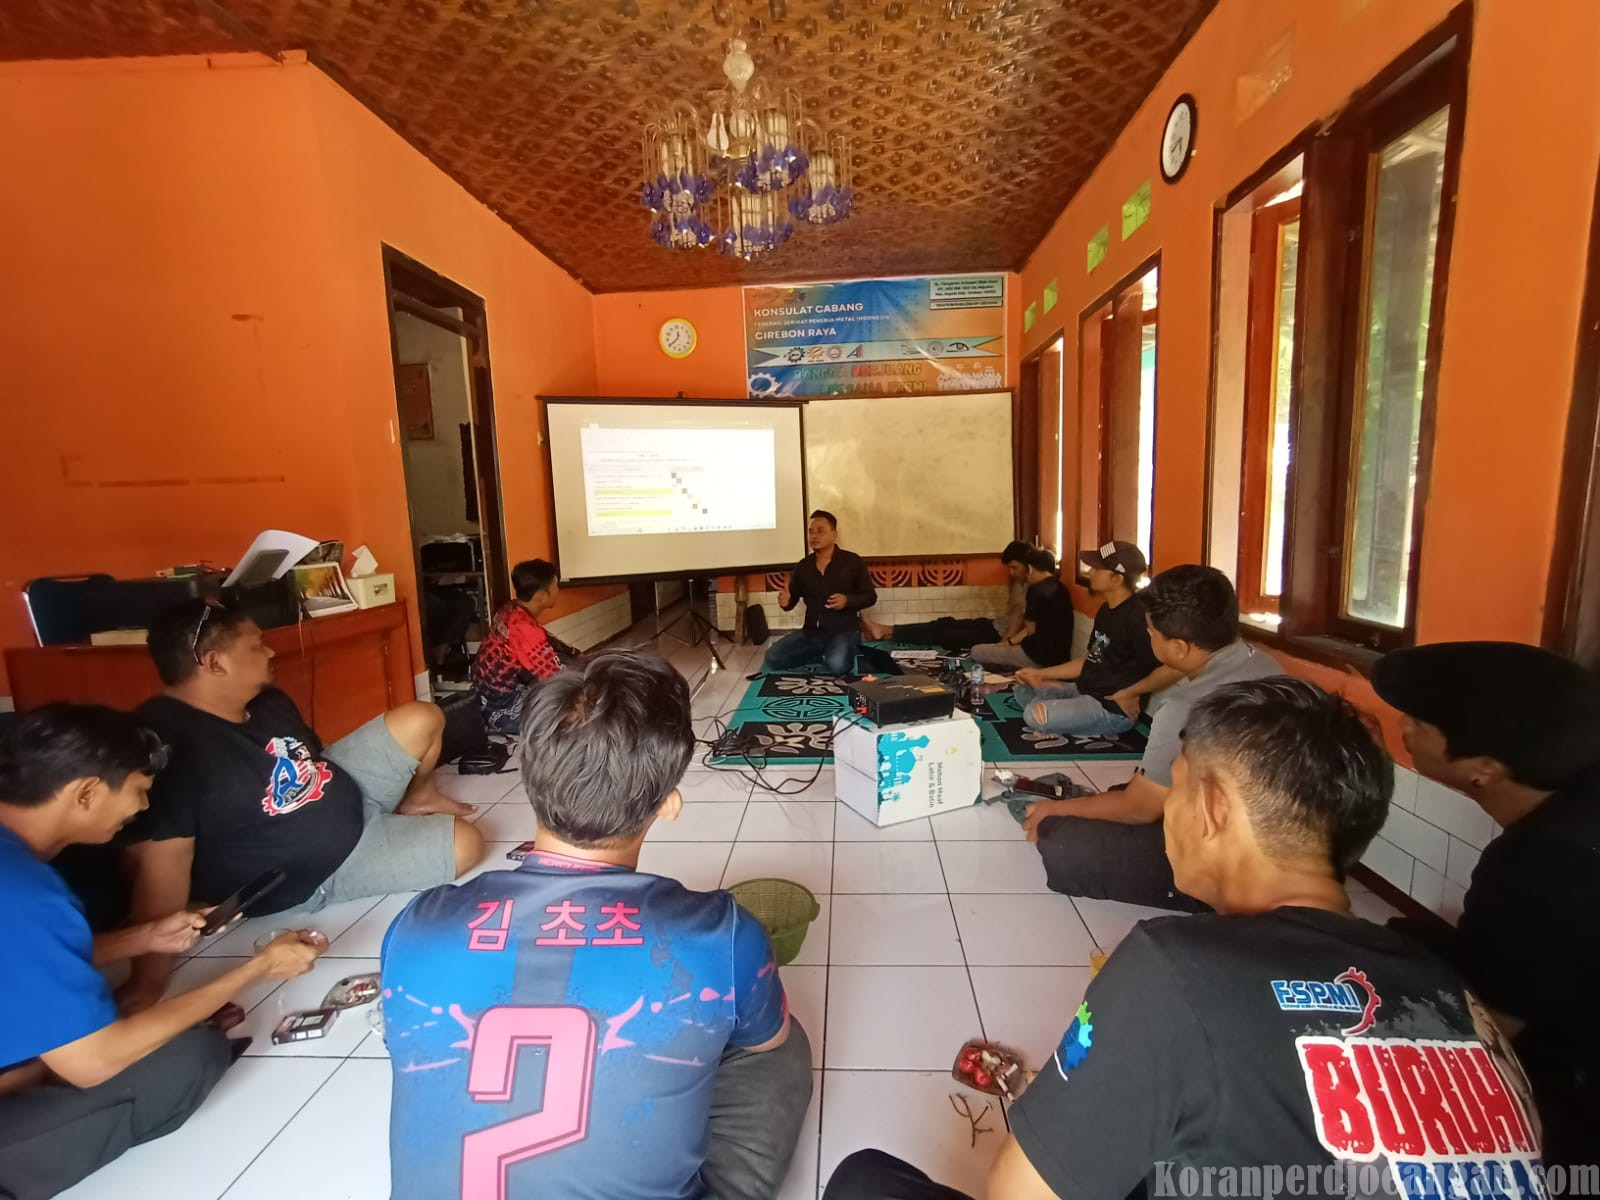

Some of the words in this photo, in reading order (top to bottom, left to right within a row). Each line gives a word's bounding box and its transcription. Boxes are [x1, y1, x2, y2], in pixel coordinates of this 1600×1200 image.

[754, 305, 813, 317] KONSULAT
[815, 302, 864, 314] CABANG
[755, 329, 805, 340] CIREBON
[808, 327, 837, 337] RAYA
[466, 898, 514, 951] 김
[1271, 980, 1360, 1007] FSPMI
[1300, 1040, 1539, 1158] BURUH
